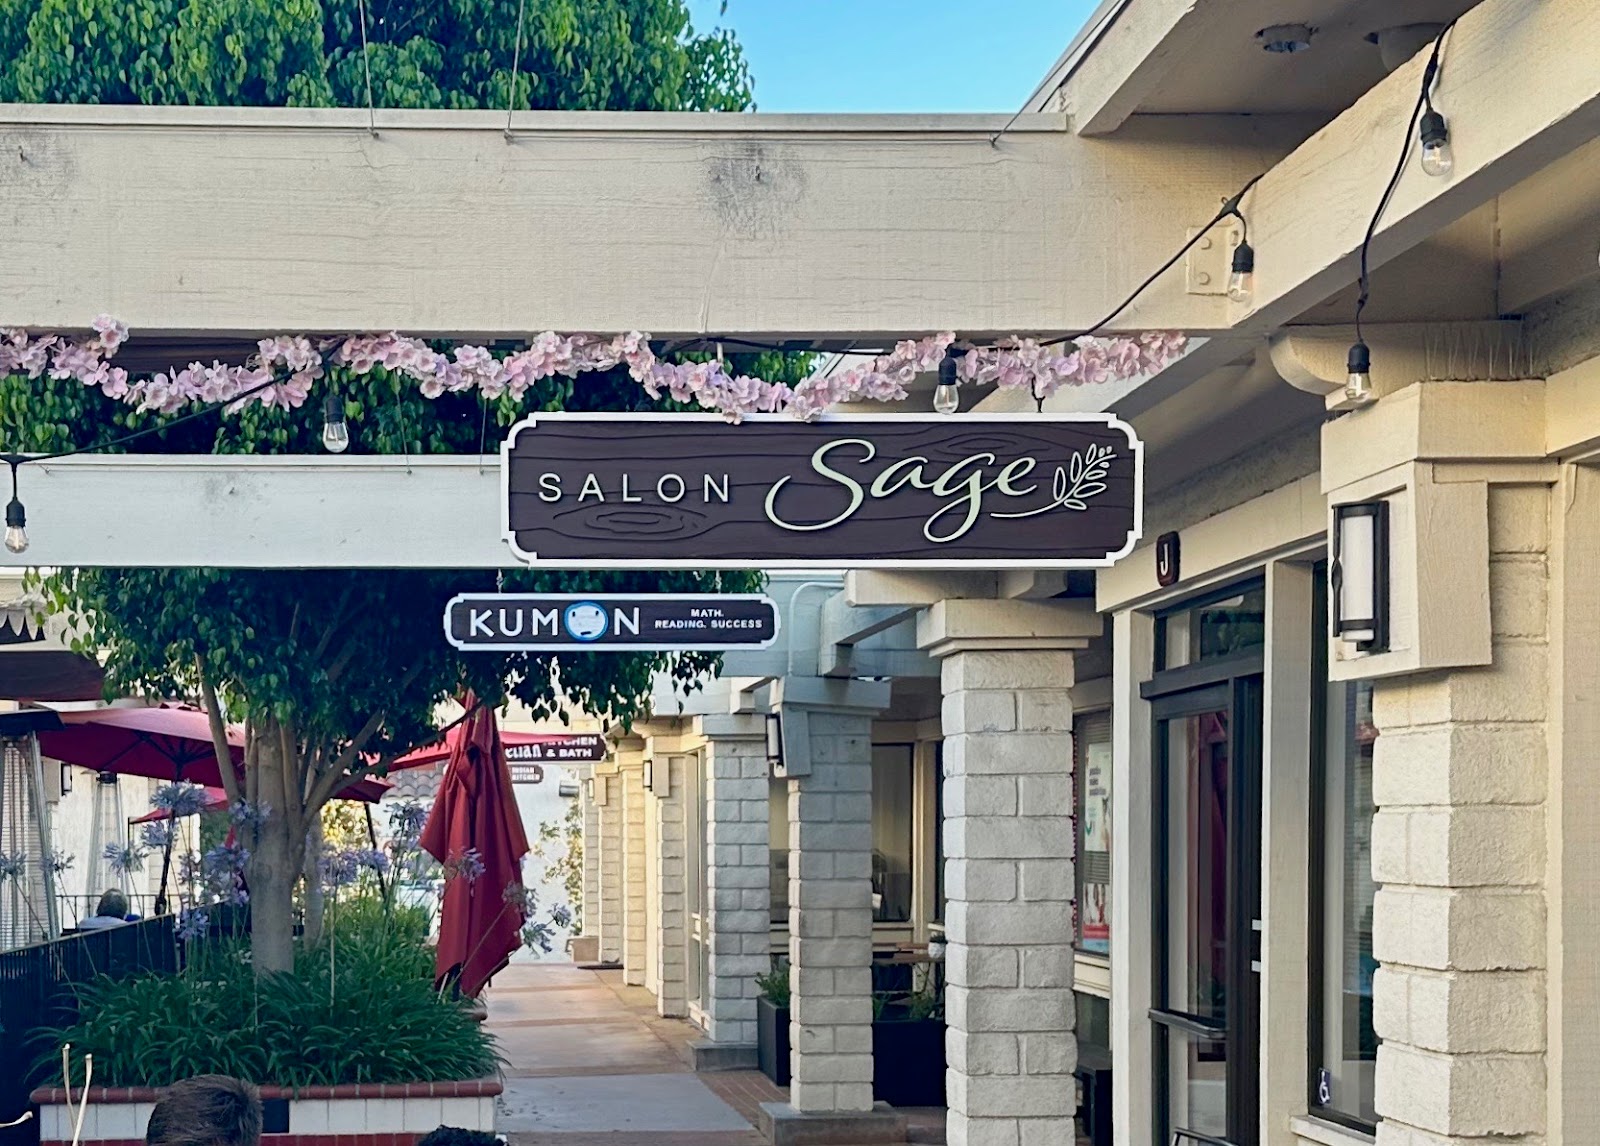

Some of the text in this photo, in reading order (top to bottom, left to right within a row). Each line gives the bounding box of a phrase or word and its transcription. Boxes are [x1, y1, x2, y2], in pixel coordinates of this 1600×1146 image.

[538, 437, 1038, 543] SALON Sage
[1160, 543, 1169, 576] J
[469, 602, 641, 642] KUMON
[711, 619, 763, 628] SUCCESS
[546, 748, 557, 758] &
[559, 748, 593, 758] BATH
